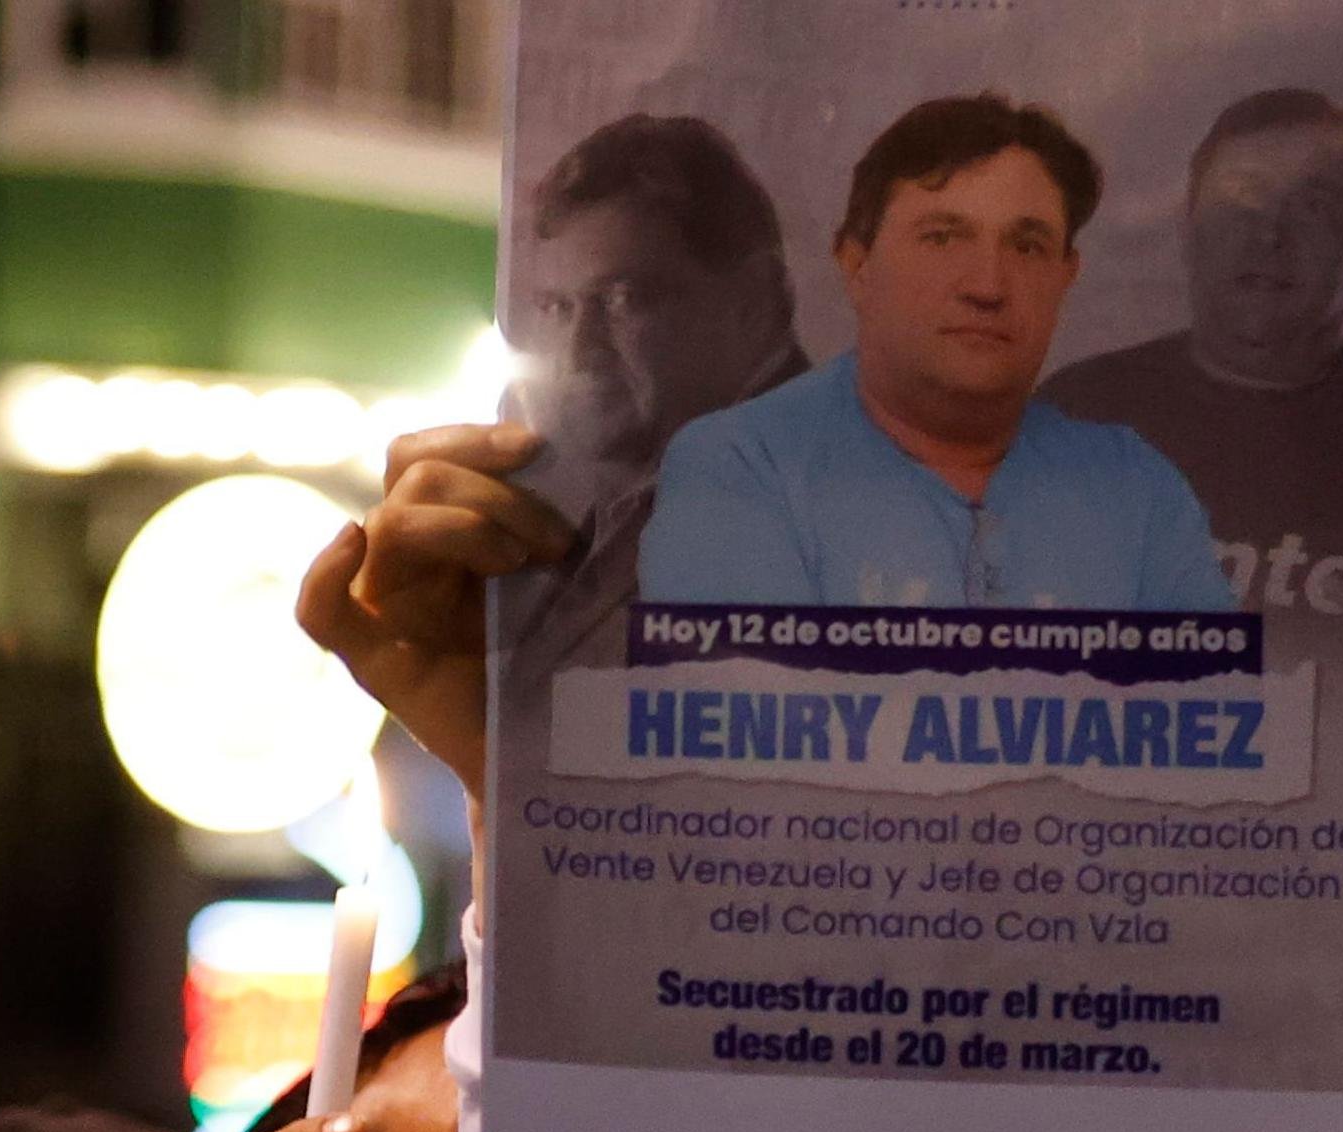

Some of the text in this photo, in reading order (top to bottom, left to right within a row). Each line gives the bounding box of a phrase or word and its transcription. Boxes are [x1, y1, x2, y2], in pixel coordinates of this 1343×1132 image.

[643, 613, 1246, 658] Hoy 12 de octubre cumple años
[628, 689, 1264, 769] HENRY ALVIAREZ
[524, 798, 773, 841] Coordinador
[786, 810, 960, 845] nacional
[970, 813, 1022, 847] de
[1035, 814, 1300, 857] Organización
[541, 845, 1341, 906] Vente Venezuela y Jefe de Organización
[710, 903, 1169, 945] del Comando Con Vzla
[658, 970, 1220, 1030] Secuestrado por el régimen
[714, 1025, 1161, 1073] desde el 20 de marzo.
